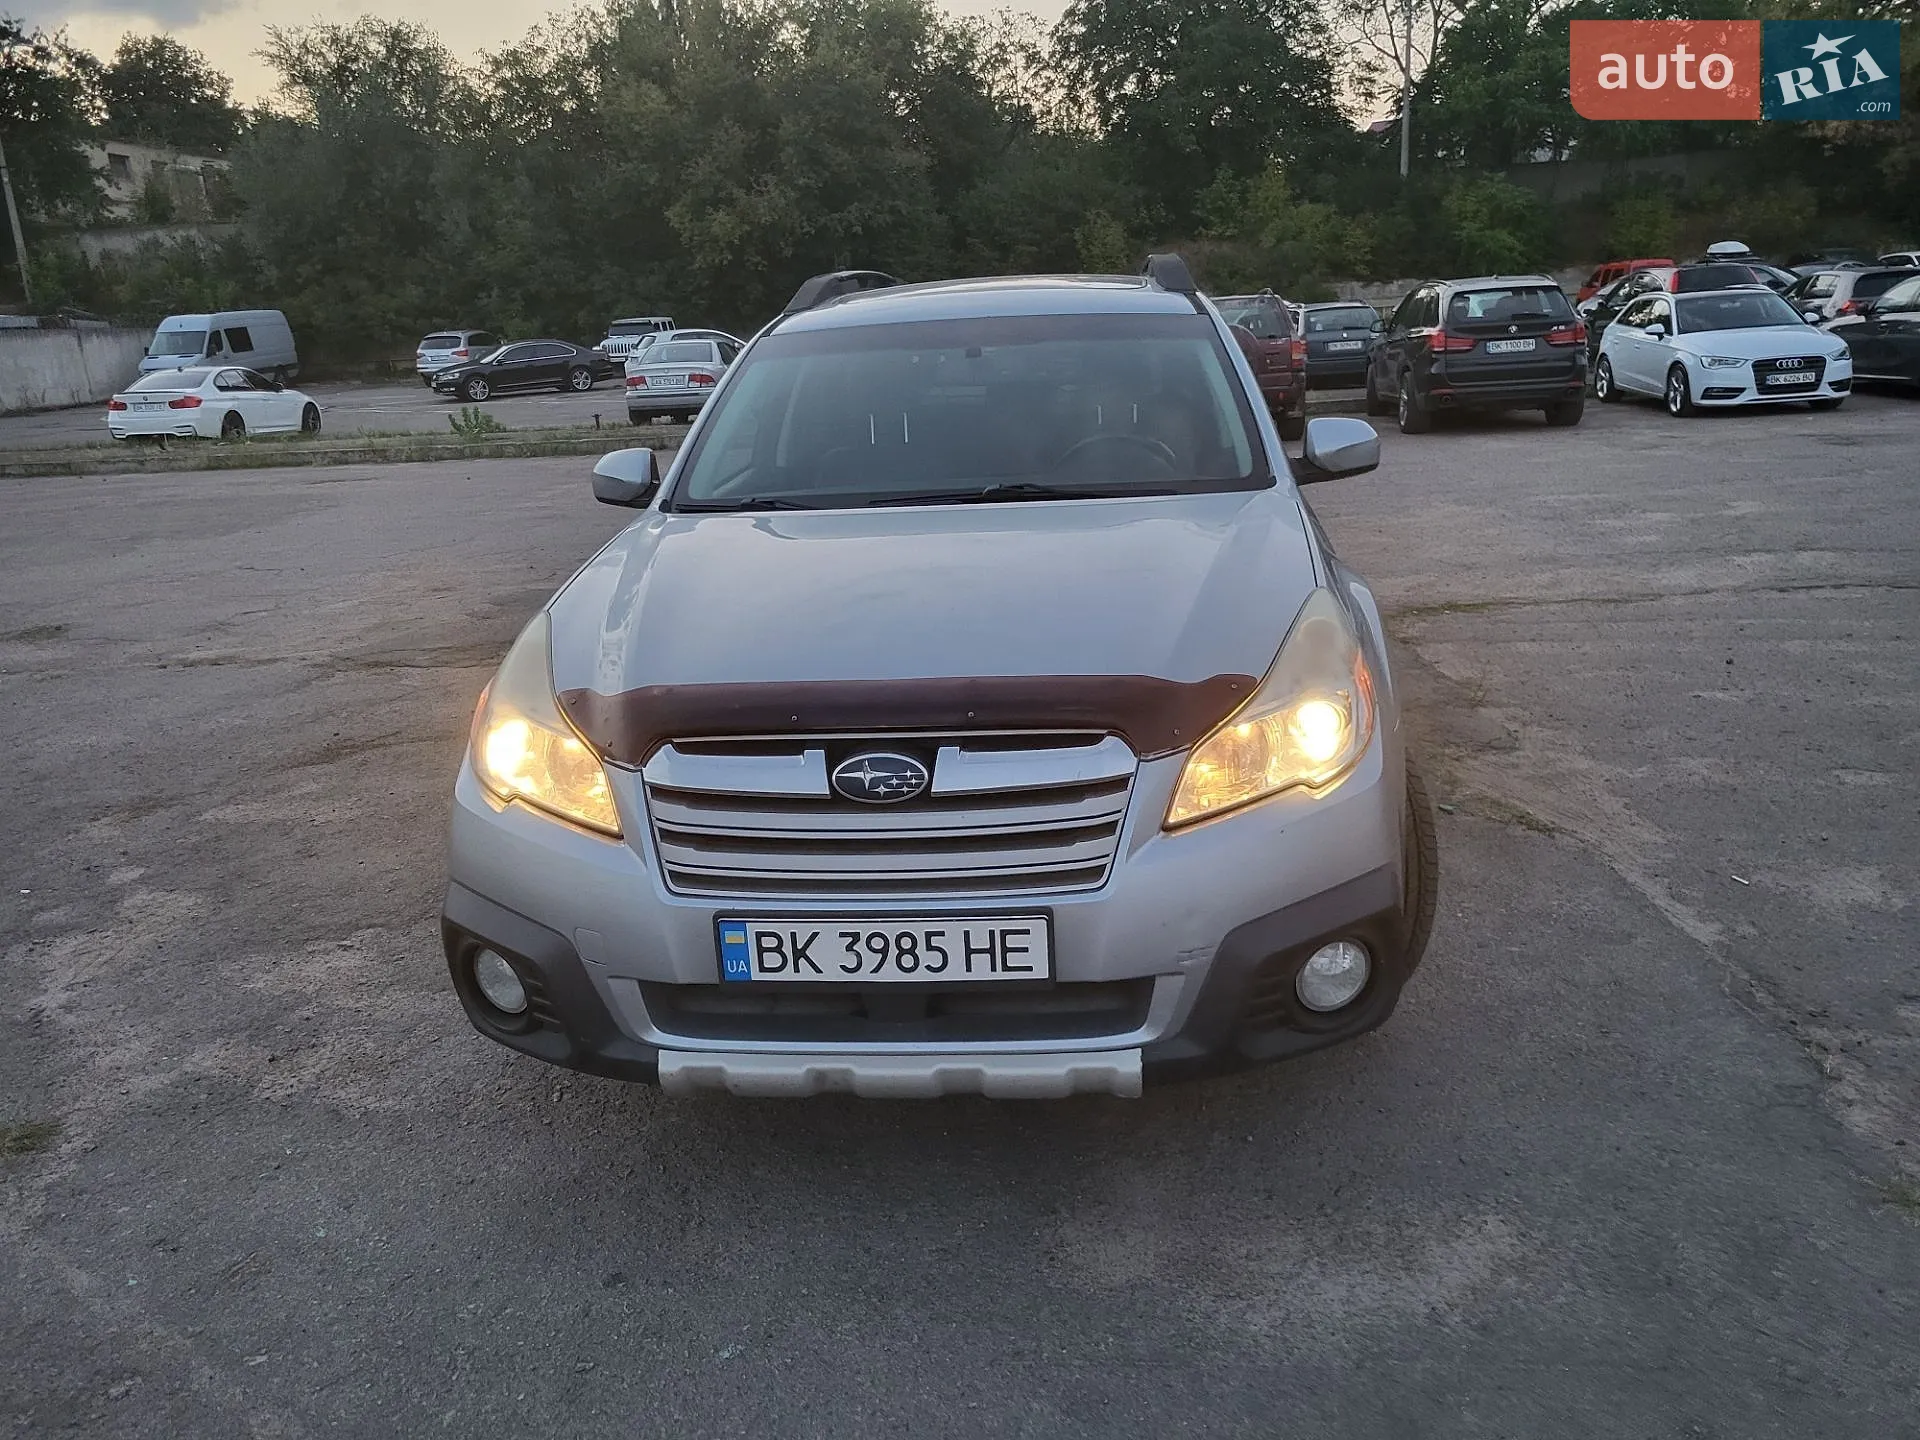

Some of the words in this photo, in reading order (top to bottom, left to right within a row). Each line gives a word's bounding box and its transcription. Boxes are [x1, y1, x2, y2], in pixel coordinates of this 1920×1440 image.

[727, 959, 748, 973] UA
[754, 929, 824, 974] BK
[838, 930, 949, 974] 3985
[963, 928, 1034, 973] HE
